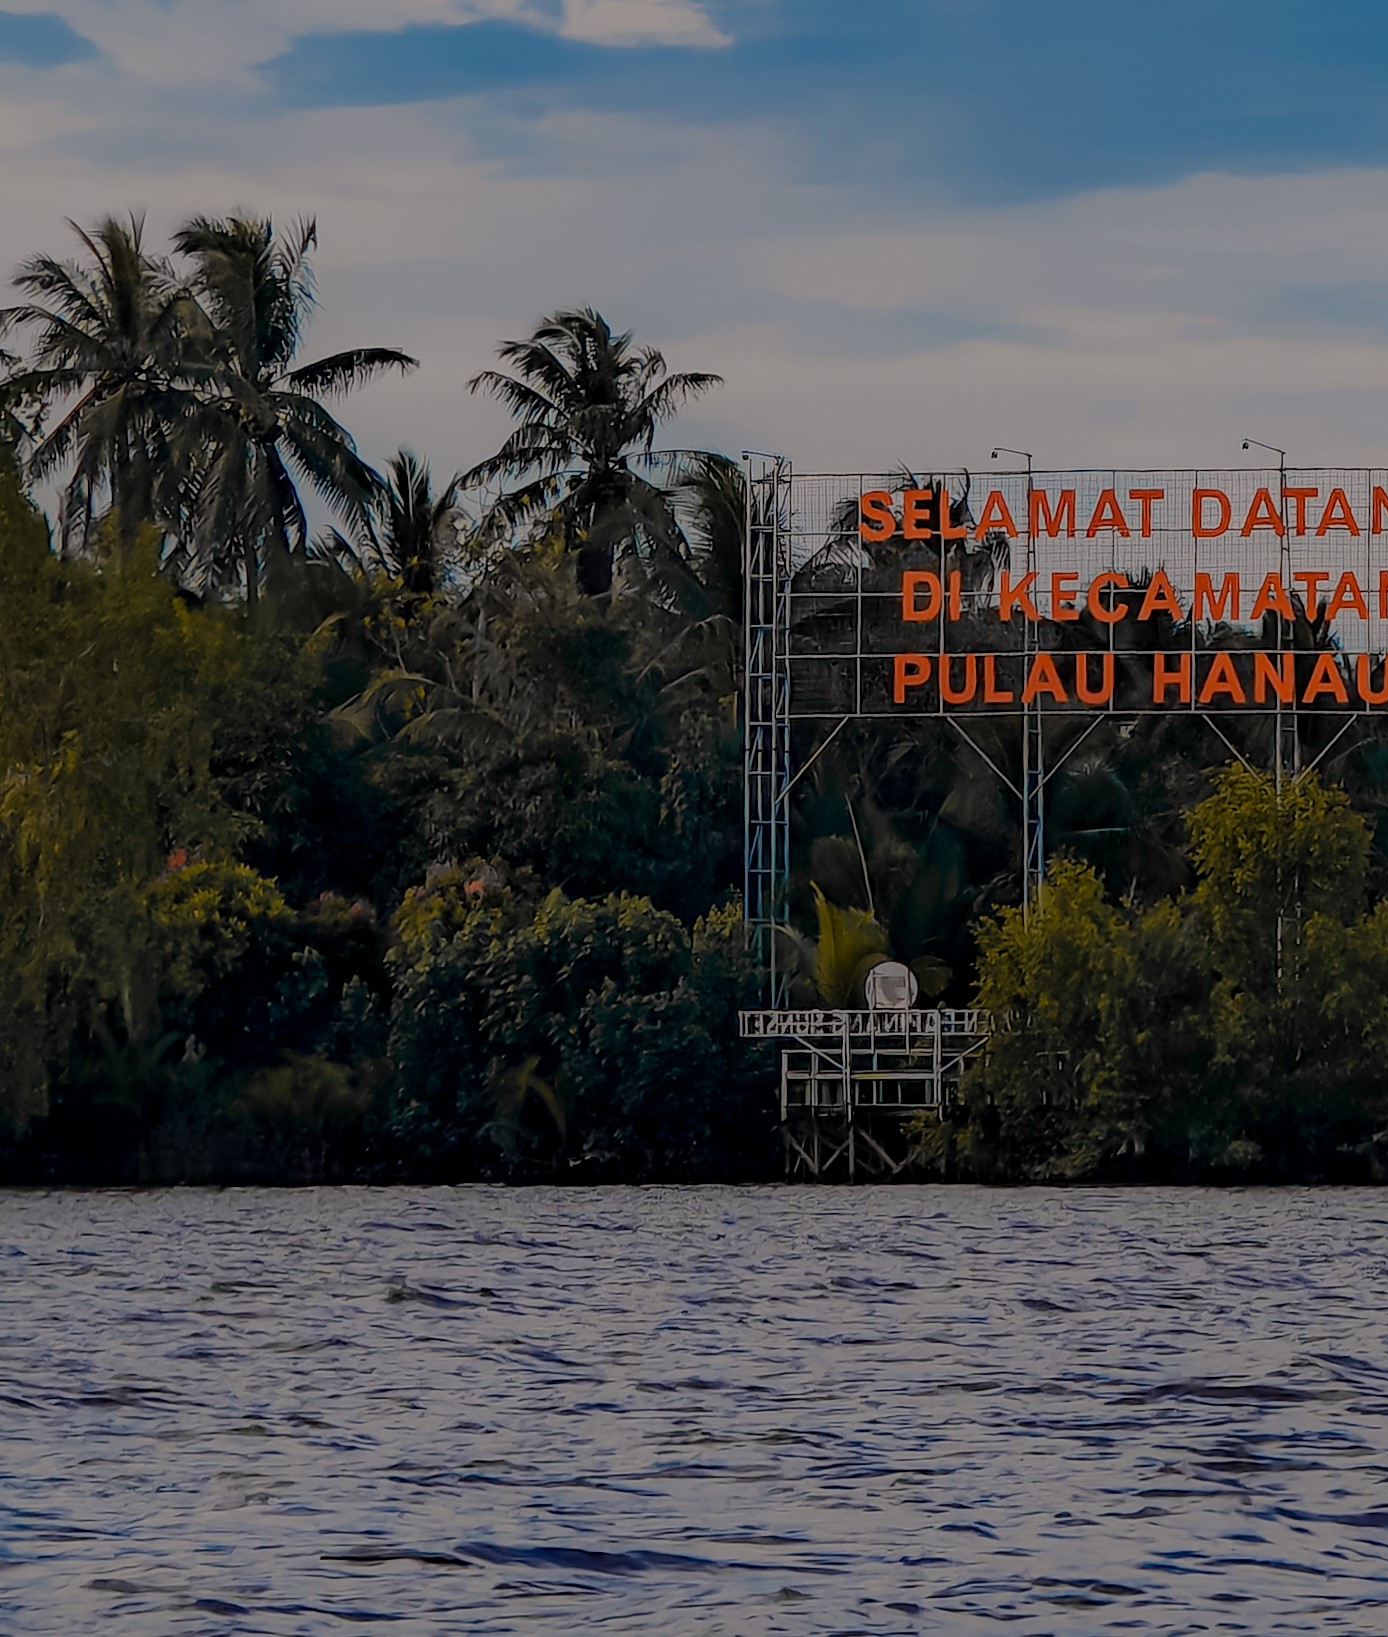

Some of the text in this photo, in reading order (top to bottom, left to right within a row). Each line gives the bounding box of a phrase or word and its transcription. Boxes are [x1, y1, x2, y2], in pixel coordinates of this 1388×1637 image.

[858, 488, 1165, 542] SELAMAT
[901, 570, 961, 622] DI
[893, 652, 1114, 704] PULAU
